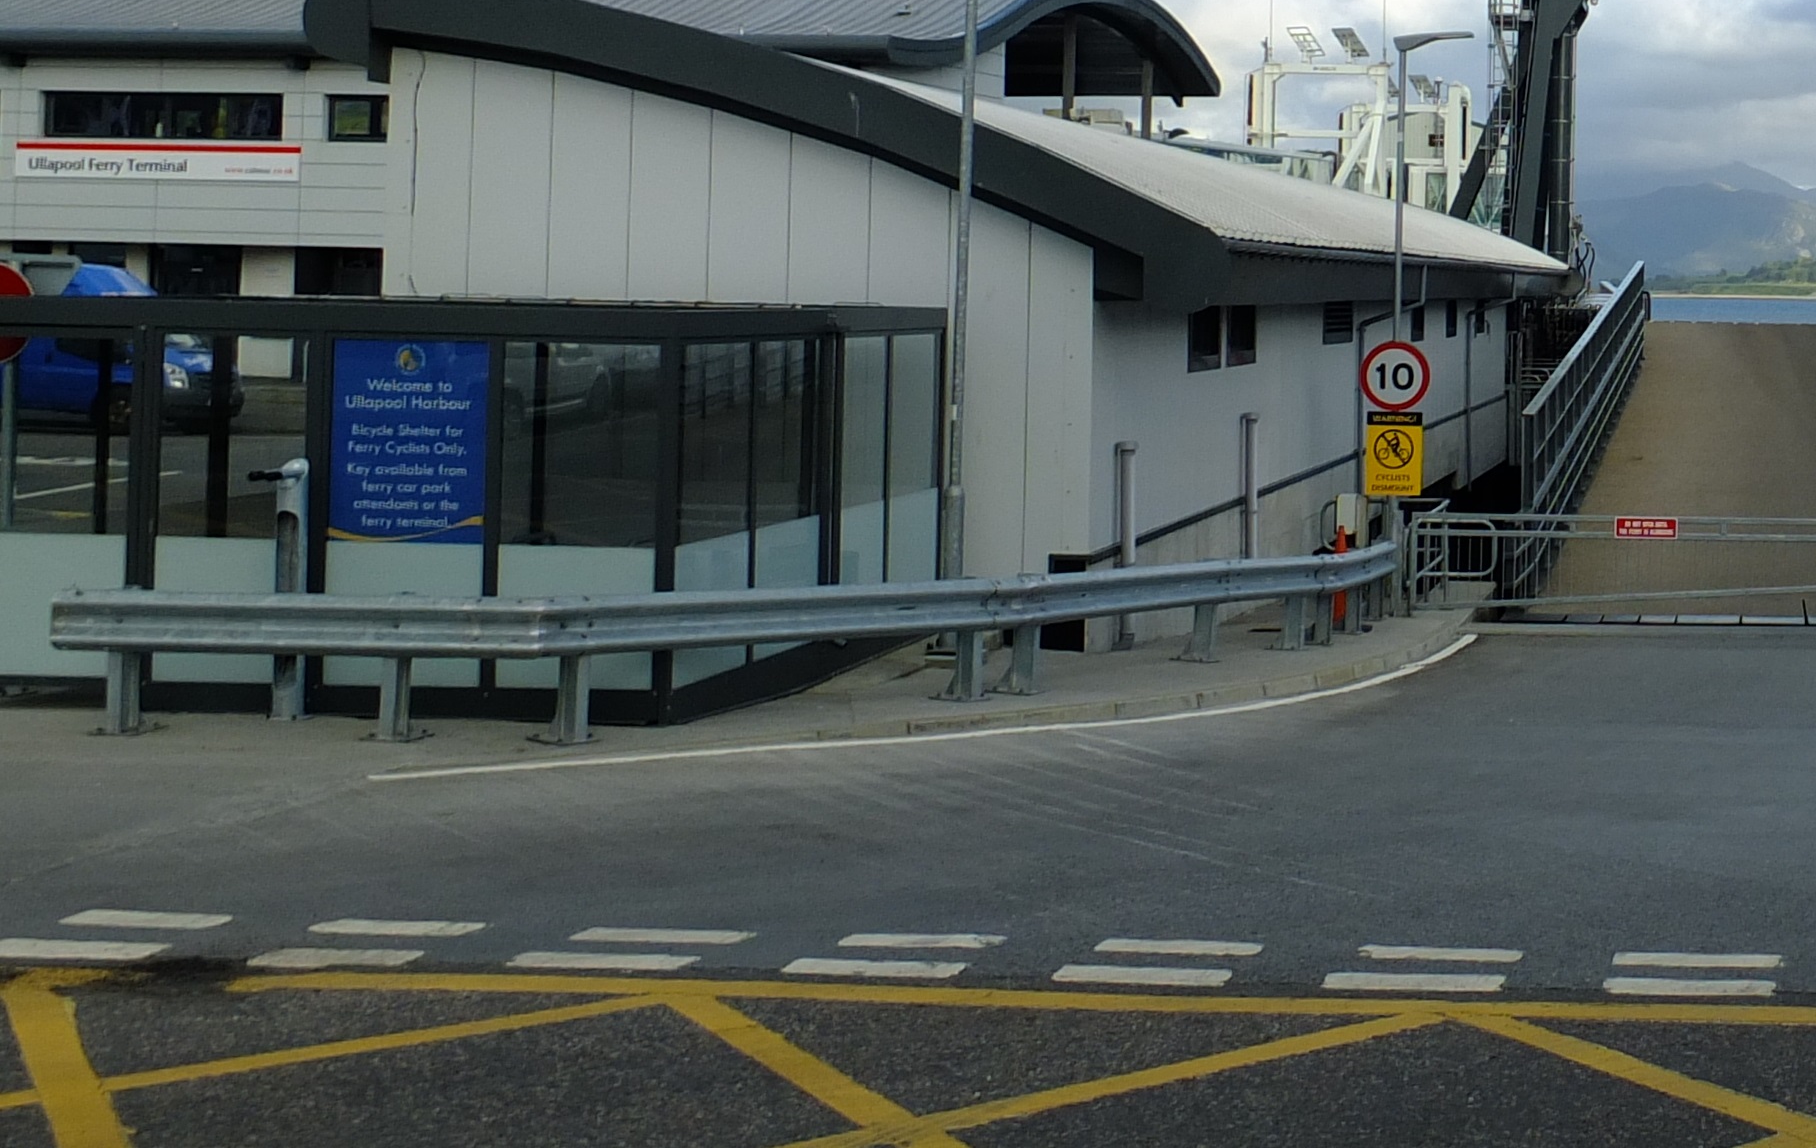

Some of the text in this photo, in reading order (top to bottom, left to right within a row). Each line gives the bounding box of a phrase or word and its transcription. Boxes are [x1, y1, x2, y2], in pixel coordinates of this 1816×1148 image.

[28, 156, 188, 175] Ullapool Ferry Terminal
[1375, 362, 1415, 390] 10
[366, 378, 453, 393] Welcome to
[344, 395, 472, 411] Ullapool Harbour
[351, 423, 464, 438] Bicycle Shelter for
[347, 440, 467, 457] Ferry Cyclists Only.
[346, 462, 468, 477] Key available from
[362, 480, 452, 495] ferry car park
[422, 500, 436, 511] or
[440, 499, 460, 511] the
[361, 515, 393, 529] ferry
